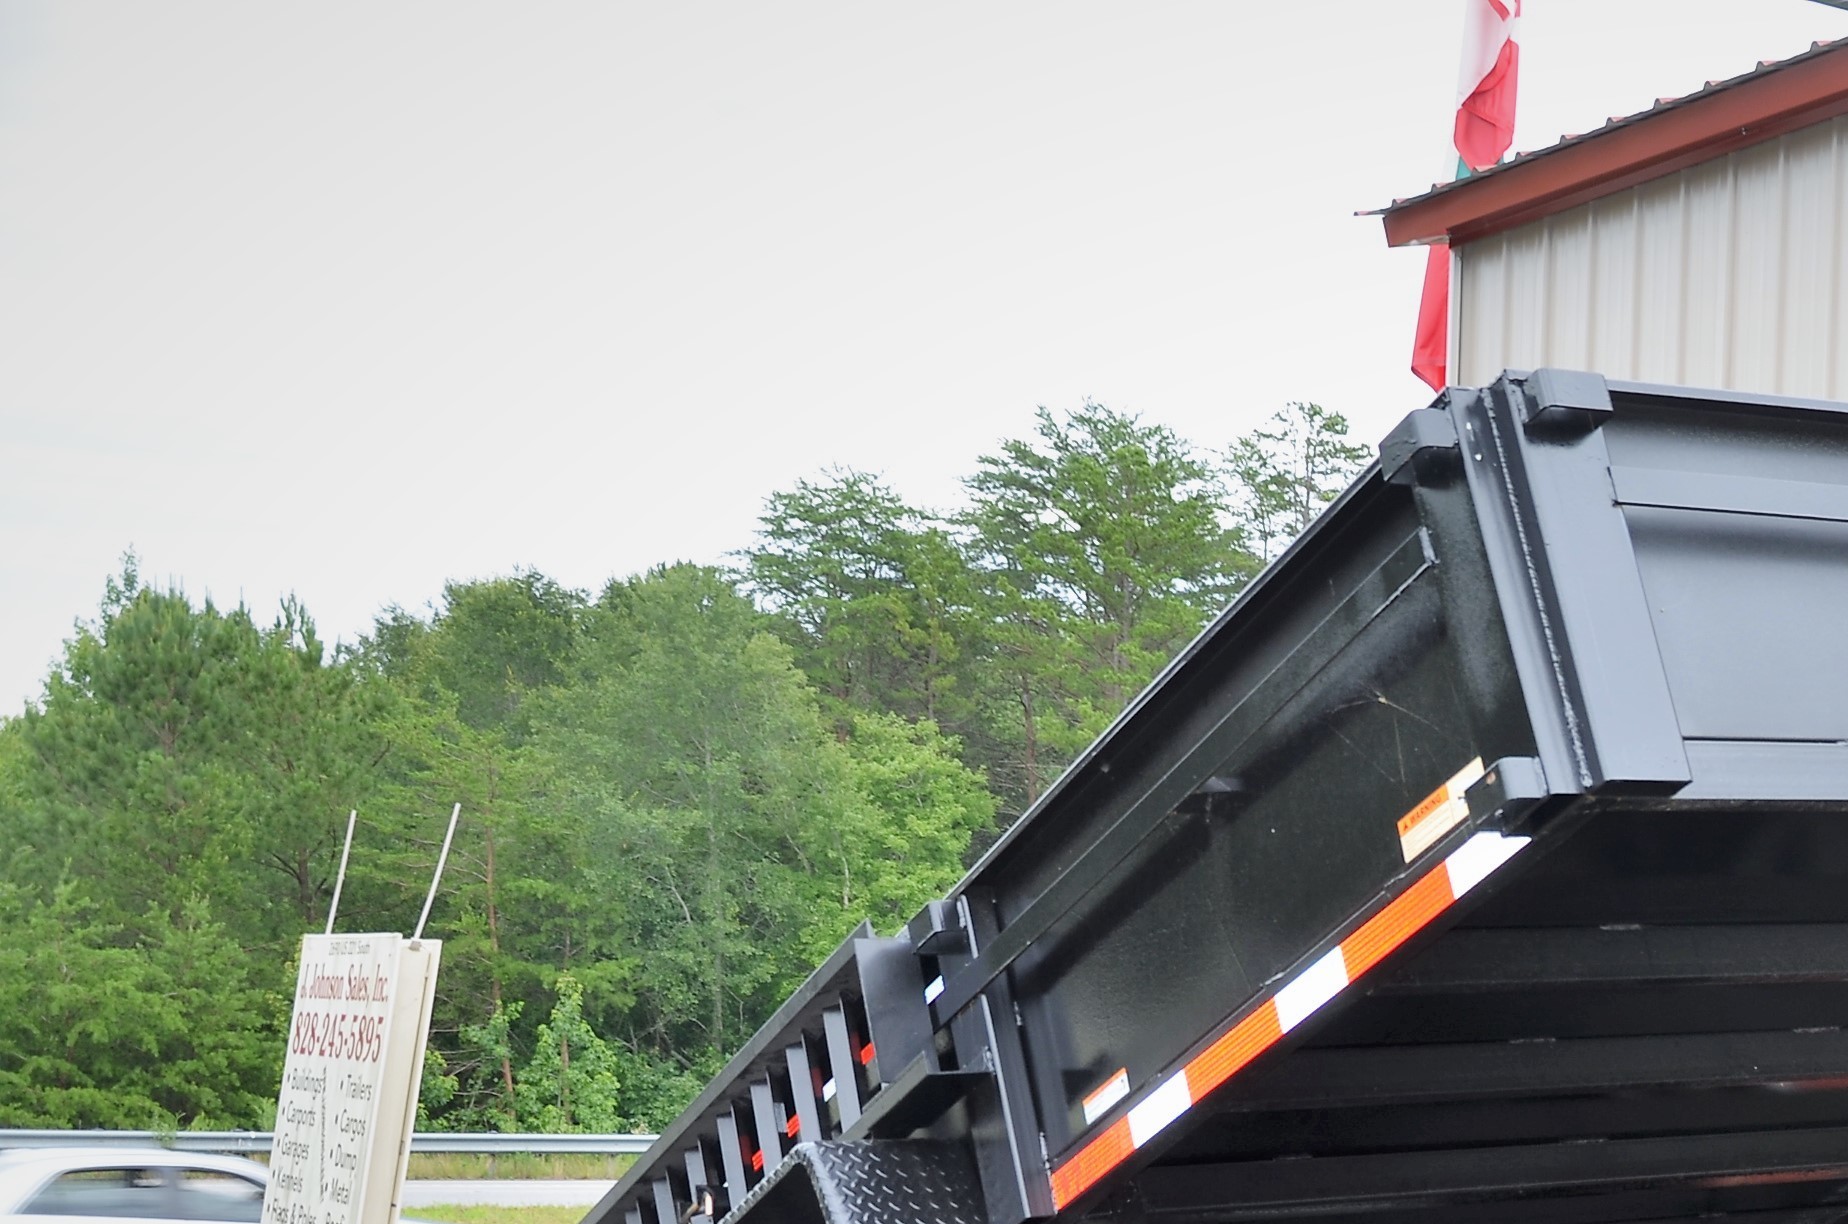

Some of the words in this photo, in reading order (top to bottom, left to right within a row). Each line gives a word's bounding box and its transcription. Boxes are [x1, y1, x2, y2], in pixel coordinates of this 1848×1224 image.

[309, 963, 344, 1000] Johnson
[345, 963, 369, 1008] Sales,
[372, 963, 388, 1003] Inc.
[292, 1011, 384, 1063] 828-245-5895
[290, 1067, 322, 1101] Buildings
[345, 1073, 372, 1101] Trailers
[286, 1100, 316, 1132] Carports
[340, 1108, 367, 1142] Cargos
[281, 1132, 310, 1165] Garages
[334, 1143, 357, 1178] Dump
[276, 1166, 303, 1194] Kennels
[329, 1178, 352, 1205] Metal
